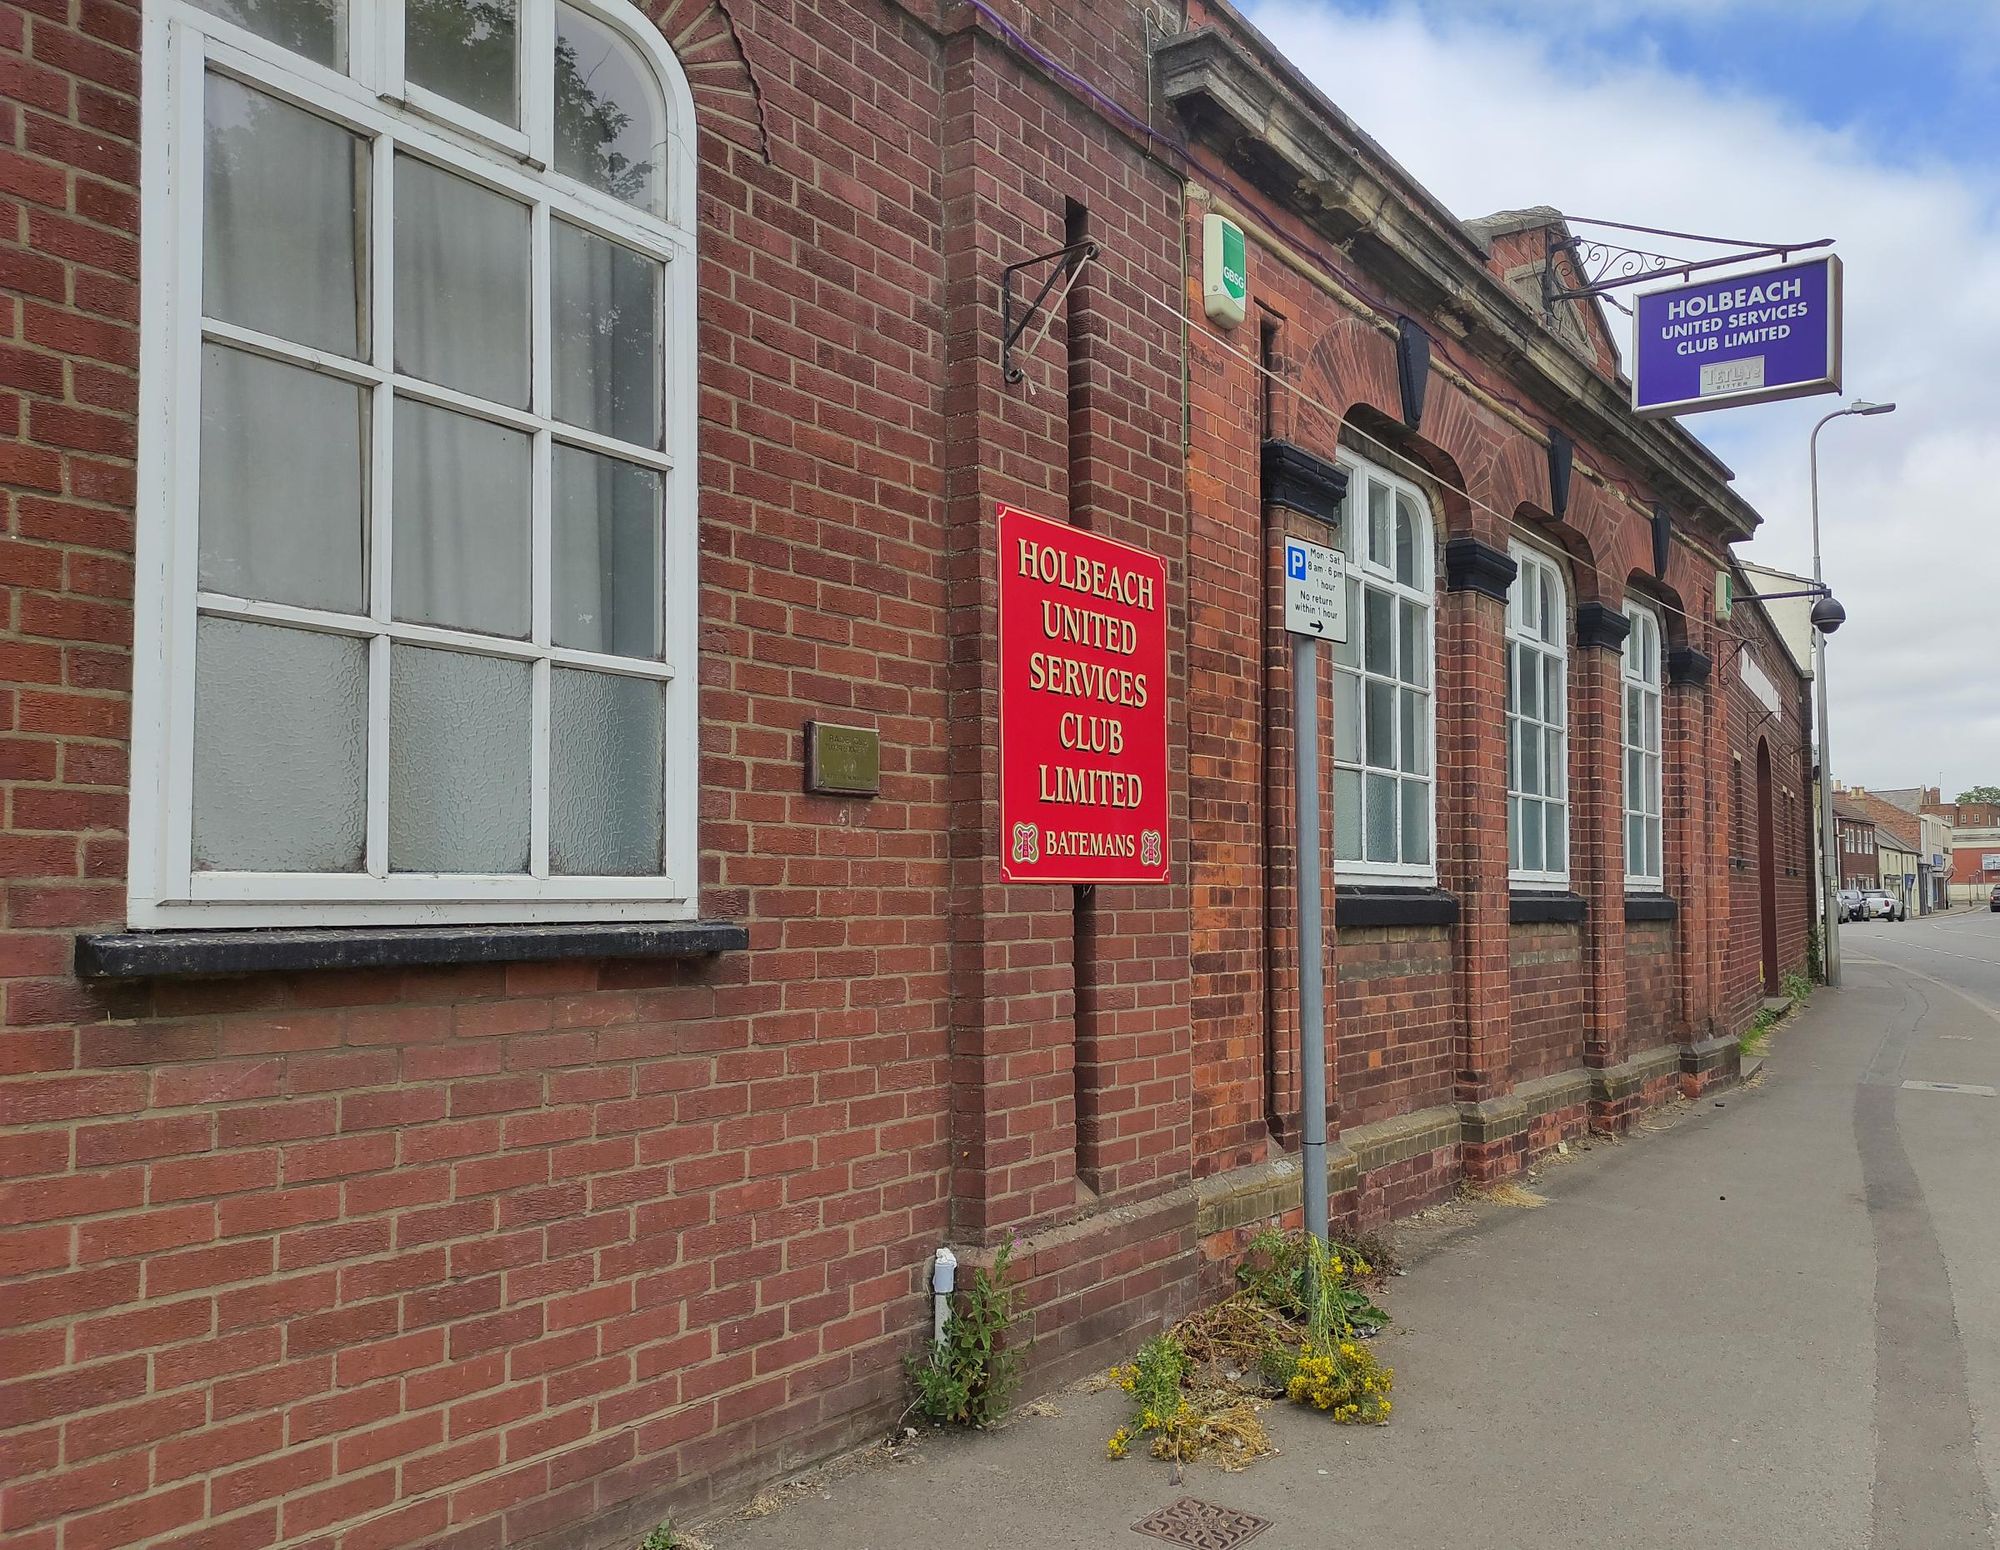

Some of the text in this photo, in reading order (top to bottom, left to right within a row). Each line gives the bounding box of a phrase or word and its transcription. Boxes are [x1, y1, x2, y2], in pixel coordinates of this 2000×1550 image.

[1224, 266, 1244, 289] GBSG
[1668, 278, 1801, 320] HOLBEACH
[1661, 302, 1808, 340] UNITED SERVICES
[1676, 324, 1791, 355] CLUB LIMITED
[1292, 550, 1304, 576] P
[1307, 561, 1312, 570] 8
[1313, 565, 1323, 573] am
[1328, 567, 1333, 576] 6
[1333, 569, 1343, 579] pm
[1310, 548, 1324, 560] Mon
[1329, 554, 1341, 565] Sat
[1017, 538, 1154, 611] HOLBEACH
[1321, 579, 1336, 591] hour
[1295, 603, 1316, 614] within
[1323, 608, 1338, 619] hour
[1300, 590, 1333, 607] No return
[1041, 599, 1137, 655] UNITED
[1029, 652, 1148, 708] SERVICES
[1059, 711, 1124, 755] CLUB
[1038, 764, 1143, 809] LIMITED
[1045, 830, 1135, 857] BATEMANS
